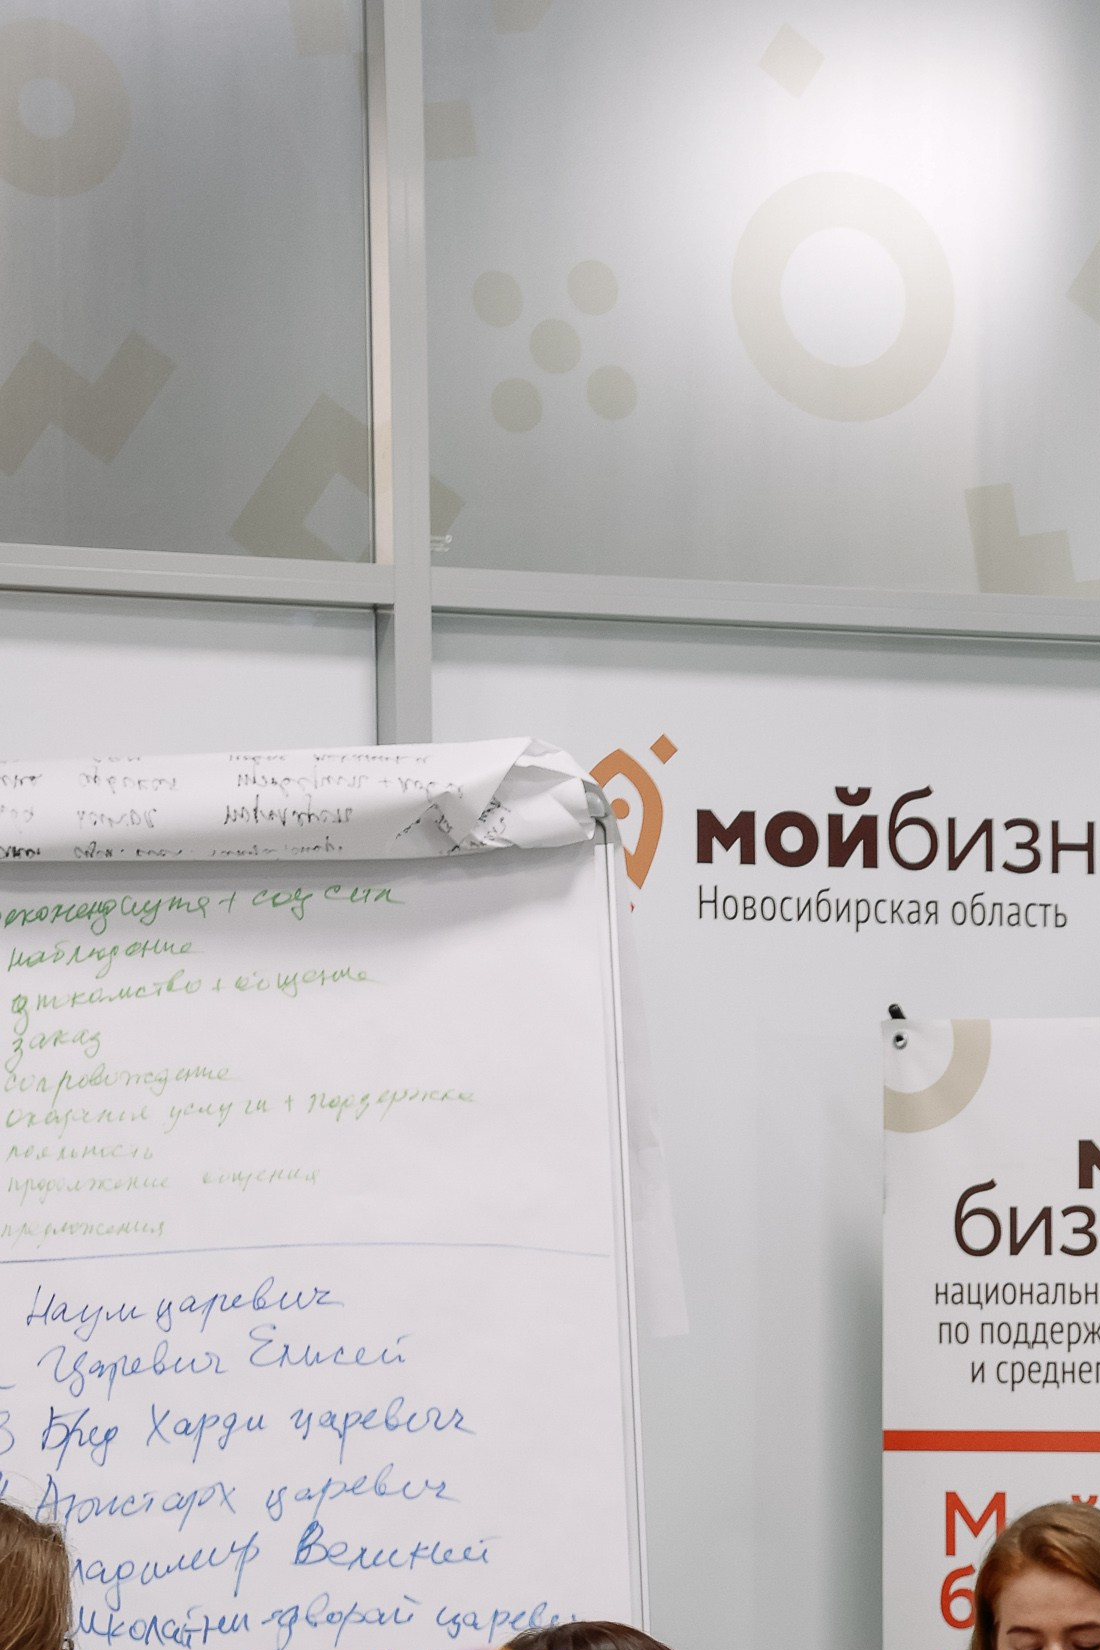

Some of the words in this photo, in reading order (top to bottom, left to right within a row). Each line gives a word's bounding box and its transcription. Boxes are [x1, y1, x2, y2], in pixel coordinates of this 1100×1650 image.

[697, 884, 939, 932] Новосибирская
[950, 892, 1069, 929] область
[5, 1029, 101, 1070] заказ
[27, 1285, 147, 1343] Наум
[156, 1276, 344, 1333] царевич
[938, 1321, 969, 1345] по
[37, 1340, 228, 1401] Царевич
[248, 1323, 411, 1367] Елисей
[971, 1360, 986, 1384] и
[146, 1403, 268, 1464] Харди
[290, 1396, 476, 1464] царевич
[265, 1463, 462, 1521] царевич
[71, 1531, 260, 1612] ладимир
[294, 1520, 492, 1571] Великий
[436, 1601, 577, 1644] царев
